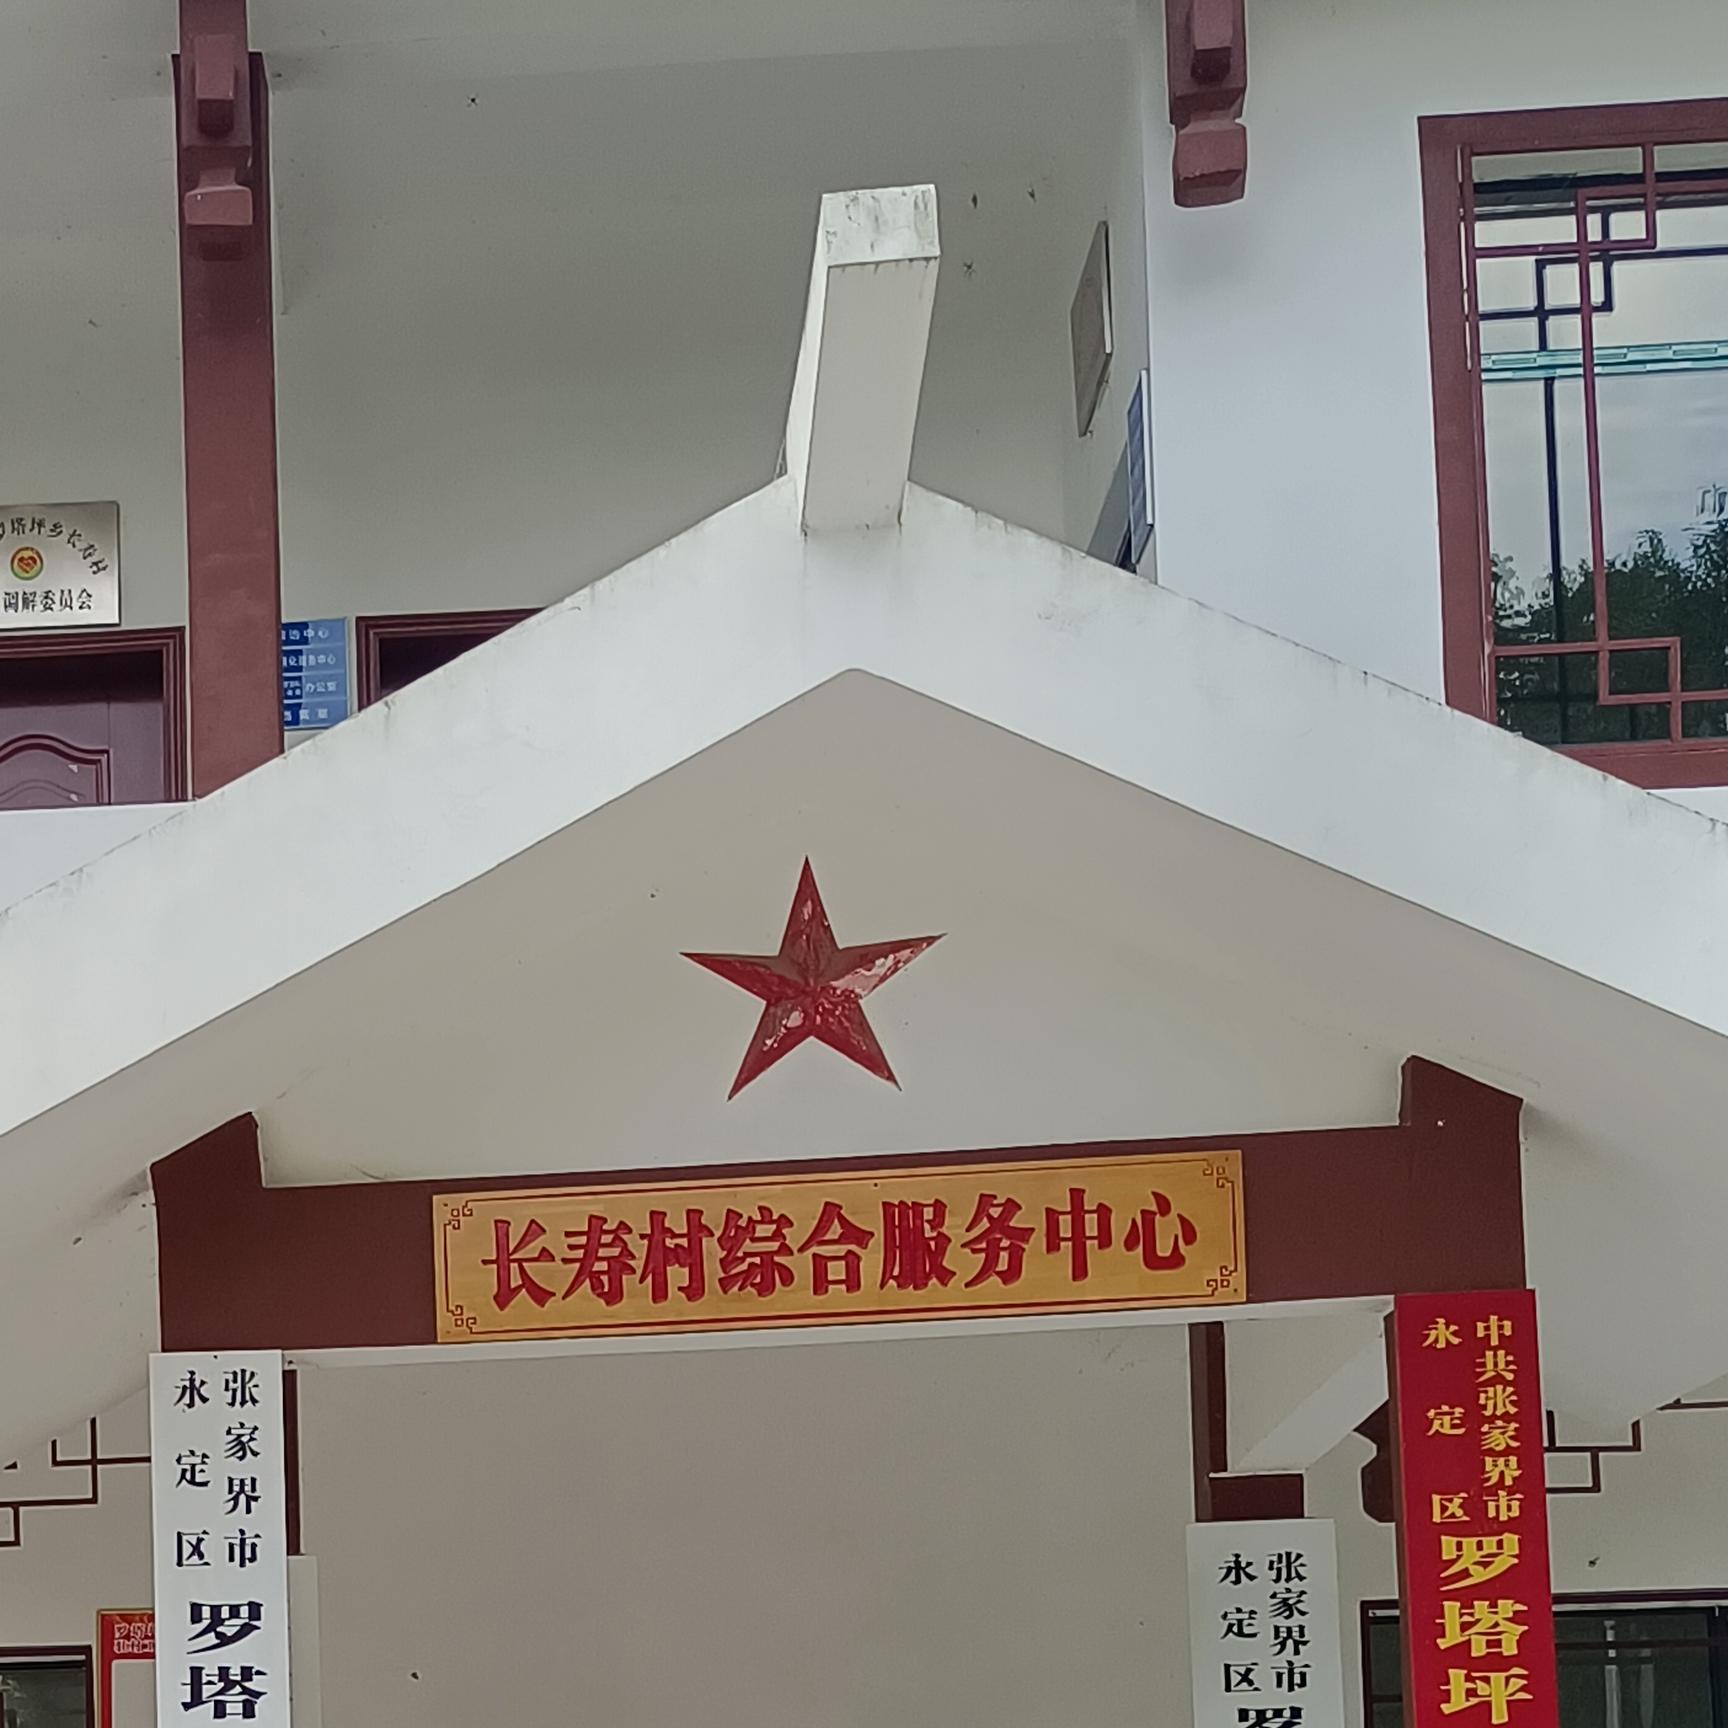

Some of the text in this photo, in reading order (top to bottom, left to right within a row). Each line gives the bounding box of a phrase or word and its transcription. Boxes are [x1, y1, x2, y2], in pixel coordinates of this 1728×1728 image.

[480, 1186, 1199, 1313] 长寿村综合服务中心
[173, 1369, 212, 1568] 永定区
[223, 1367, 262, 1569] 张家界市
[1422, 1317, 1471, 1523] 永定区
[1474, 1314, 1525, 1523] 中共张家界市
[1217, 1552, 1262, 1693] 永定区
[1267, 1550, 1313, 1693] 张家界市
